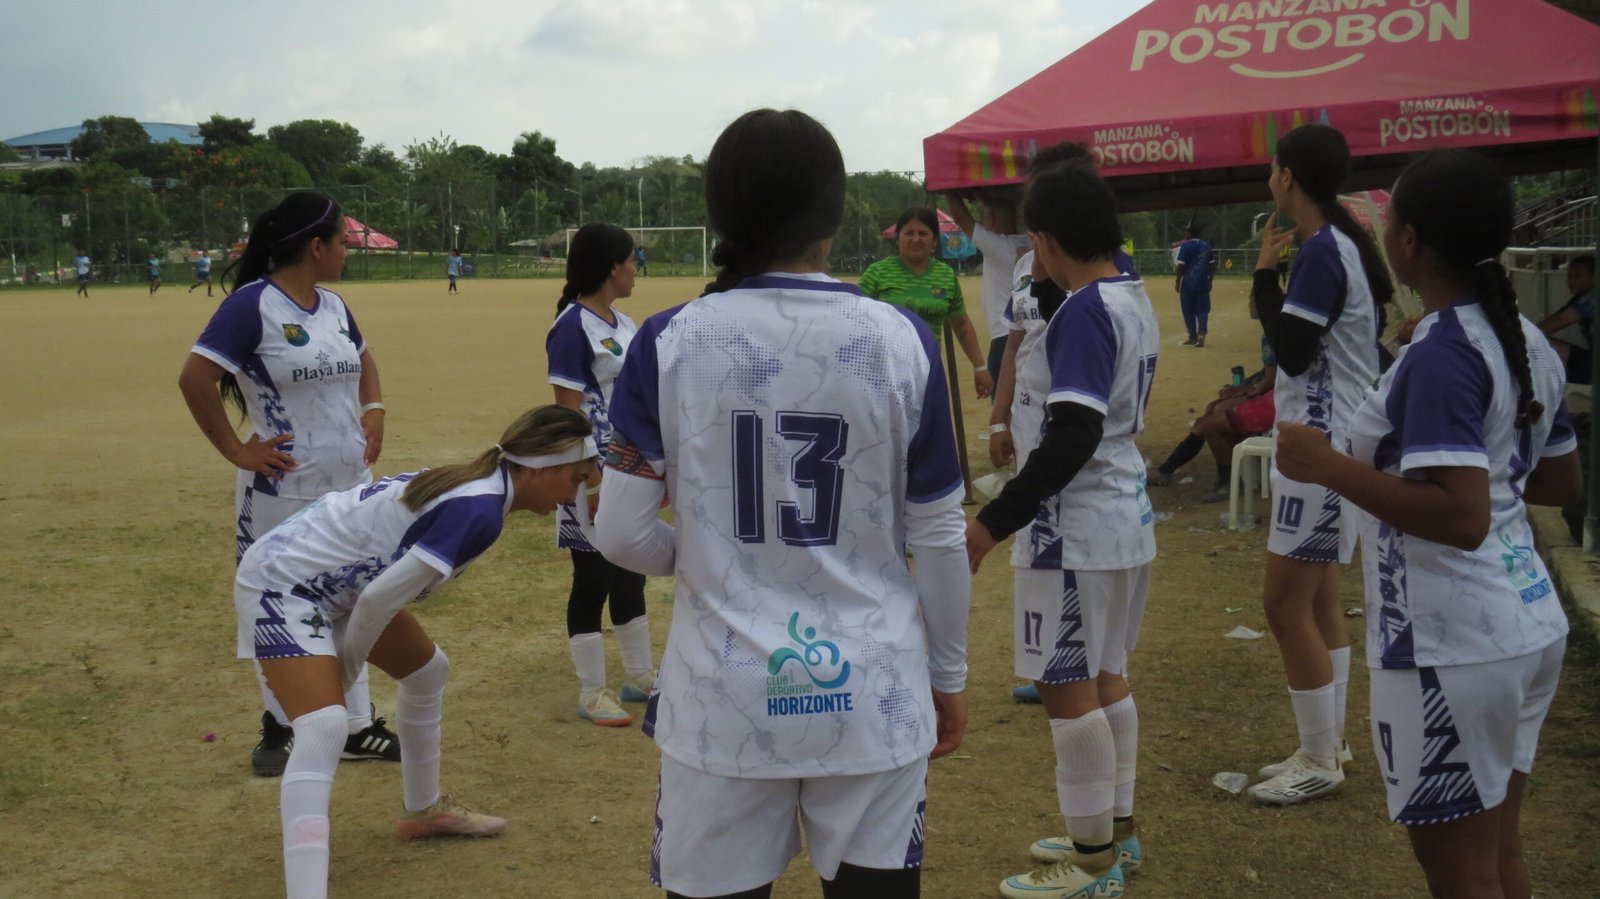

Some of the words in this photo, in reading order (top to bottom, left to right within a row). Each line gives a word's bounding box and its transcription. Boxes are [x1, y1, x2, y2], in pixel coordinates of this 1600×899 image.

[1400, 97, 1476, 114] MANZANA
[1094, 124, 1164, 144] MANZANA
[1092, 136, 1194, 168] OSTOBON
[292, 366, 333, 382] Playa
[731, 410, 850, 548] 13
[1277, 494, 1305, 528] 10
[1024, 609, 1043, 647] 17
[766, 675, 788, 686] CLUB
[767, 683, 813, 696] DEPORTIVO
[767, 692, 854, 716] HORIZONTE
[1378, 721, 1394, 772] 9
